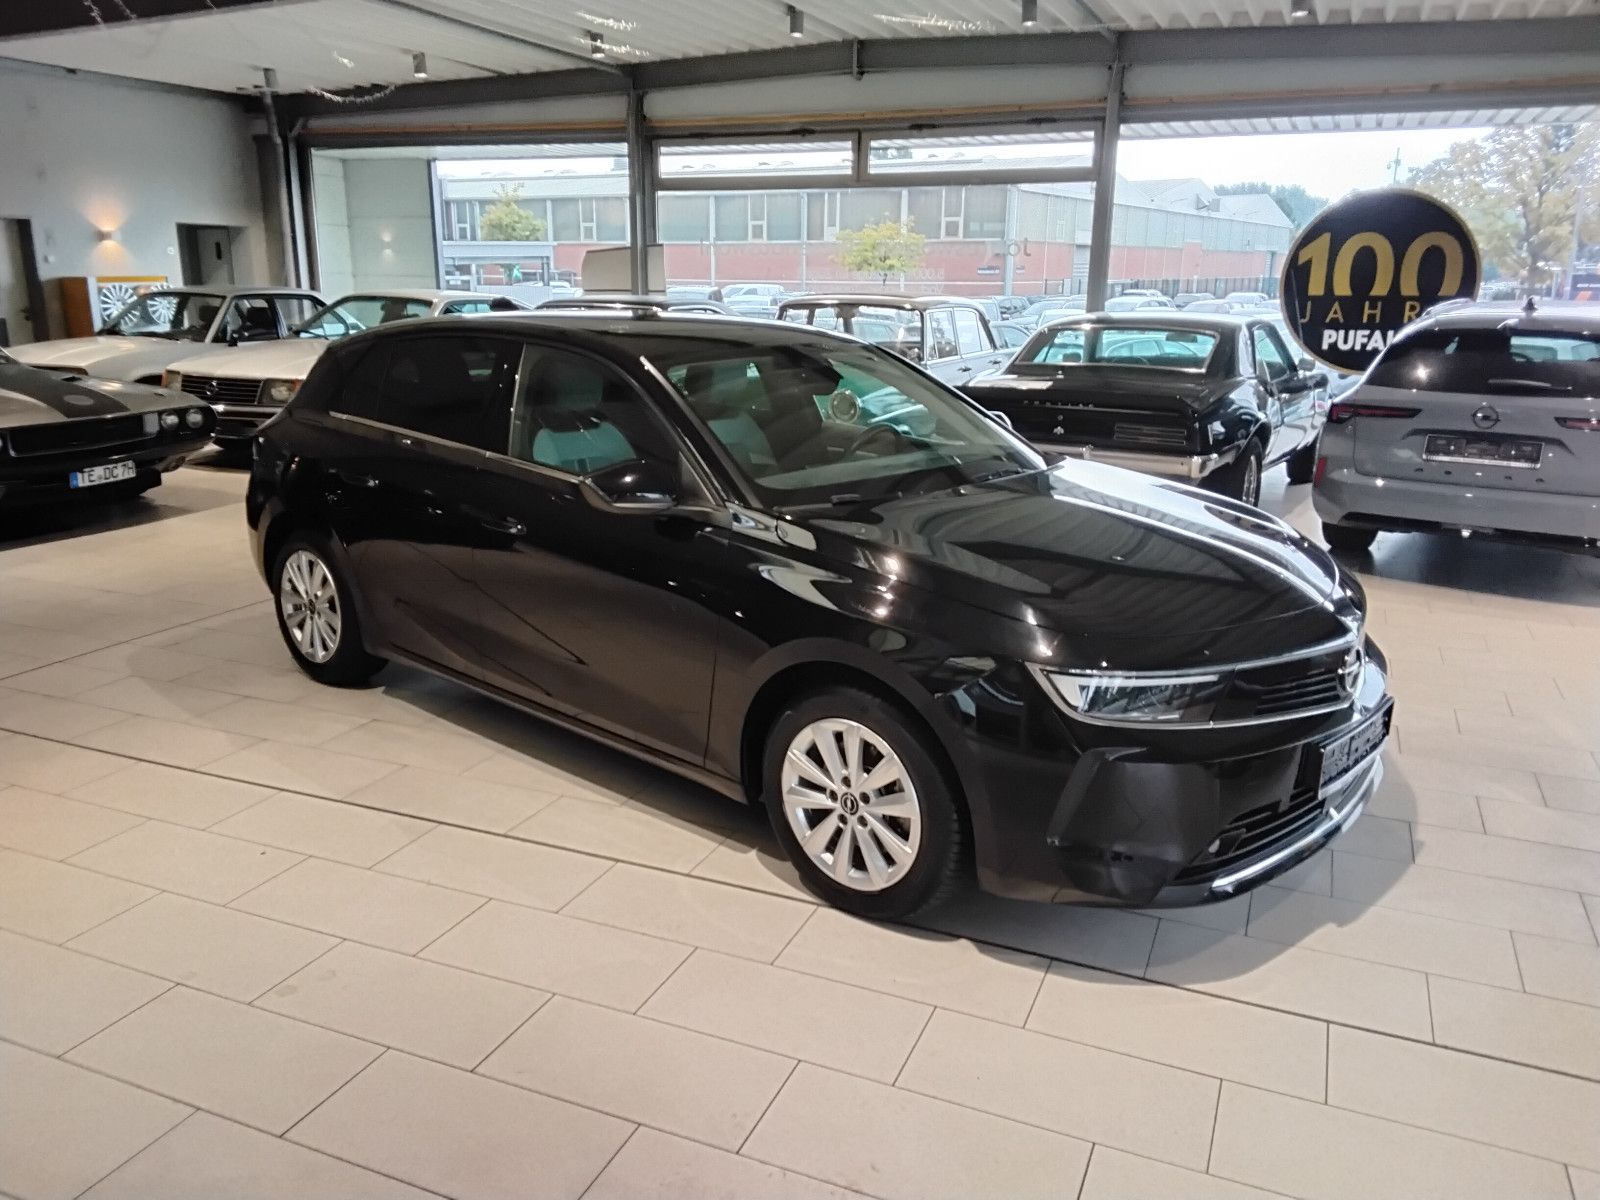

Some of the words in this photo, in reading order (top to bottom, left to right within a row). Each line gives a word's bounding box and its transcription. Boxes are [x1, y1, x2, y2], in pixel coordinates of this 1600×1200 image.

[1297, 232, 1463, 297] 100
[81, 469, 96, 485] TE
[103, 466, 119, 480] DC
